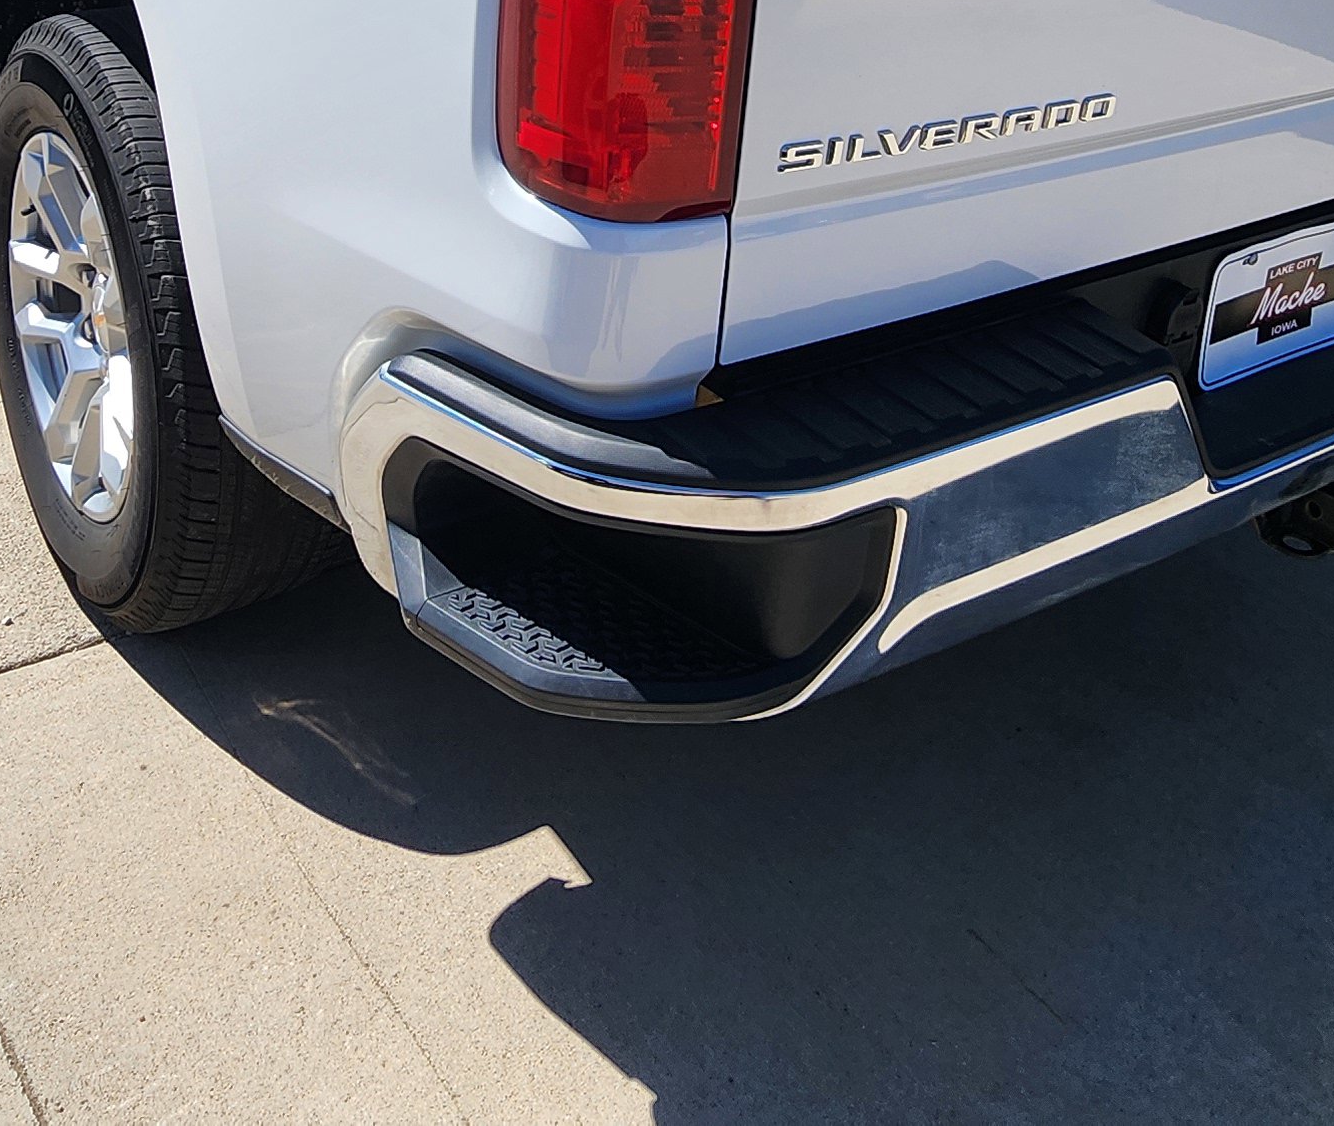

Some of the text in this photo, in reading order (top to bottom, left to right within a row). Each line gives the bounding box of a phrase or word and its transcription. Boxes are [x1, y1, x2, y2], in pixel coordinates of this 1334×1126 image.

[777, 92, 1117, 173] SILVERADO
[1269, 255, 1319, 280] LAKE CITY
[1250, 271, 1327, 325] Macke
[1270, 318, 1299, 336] IOWA
